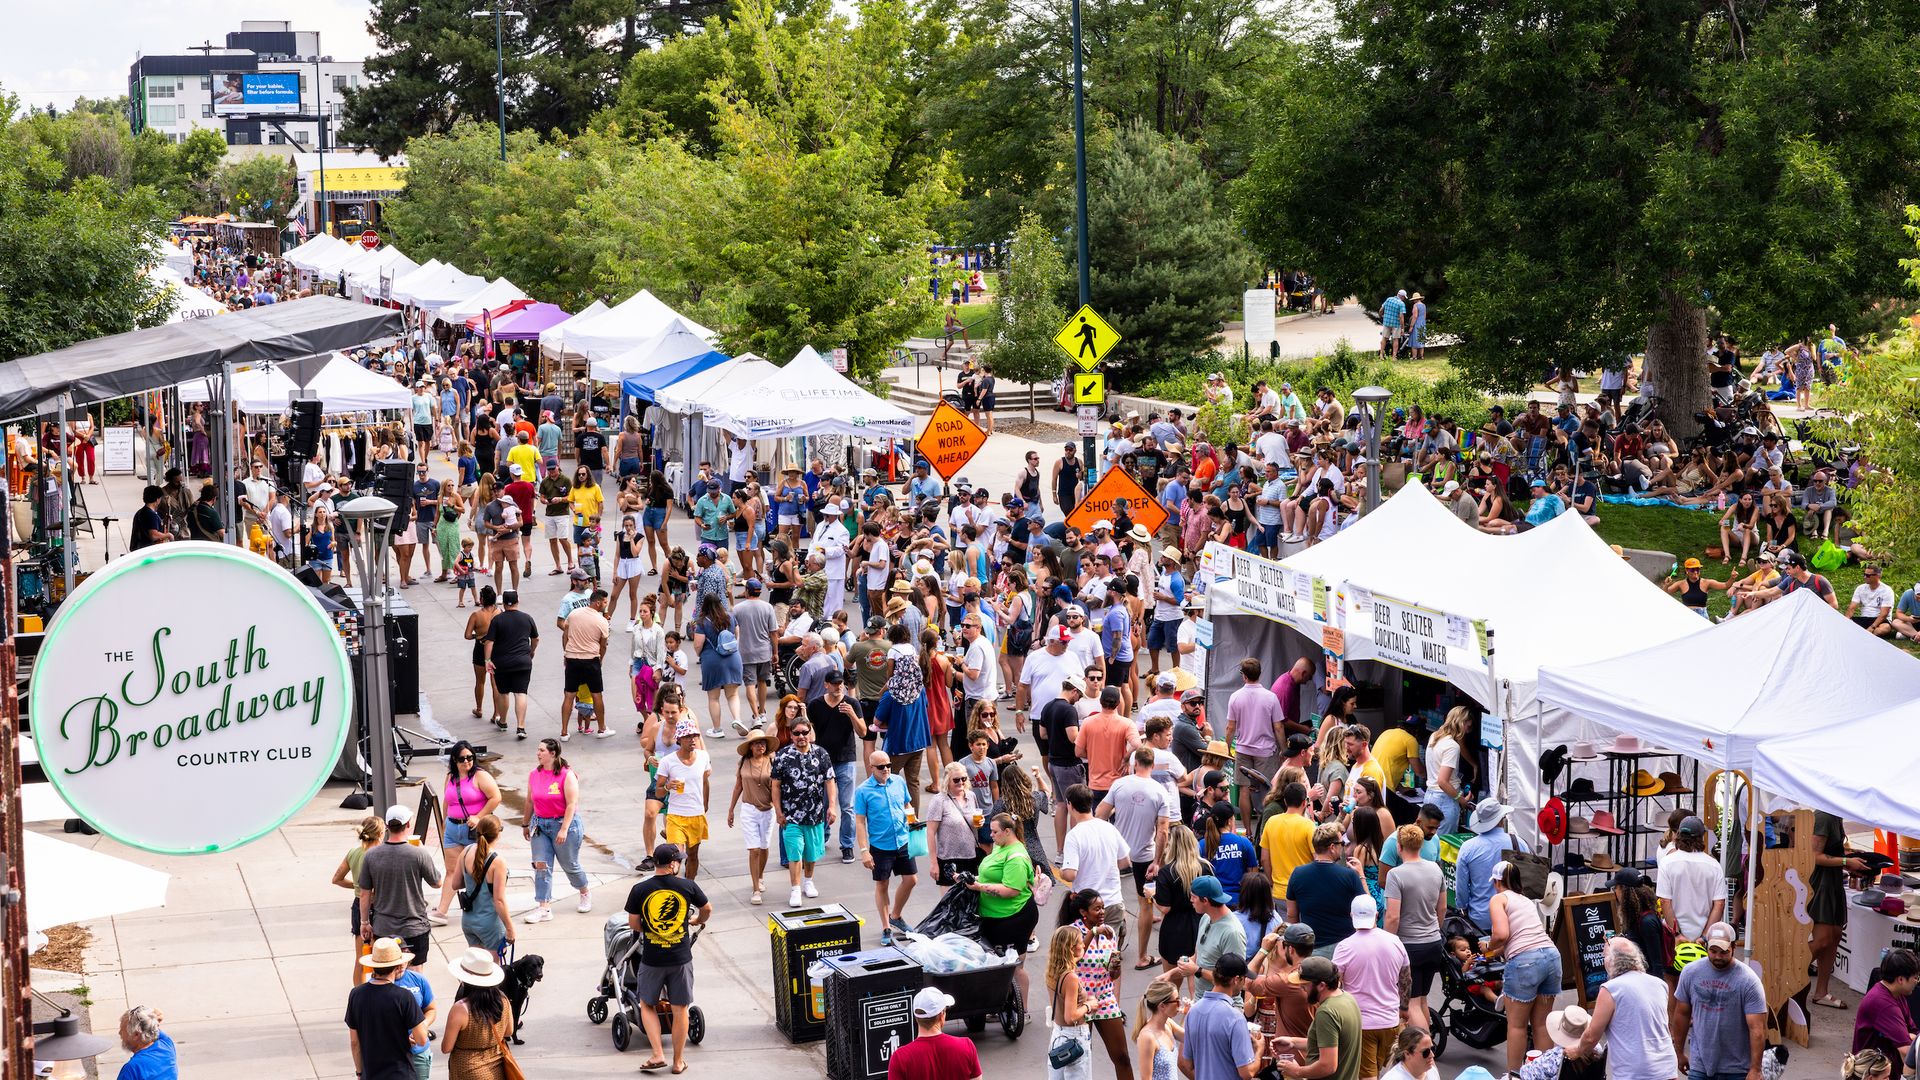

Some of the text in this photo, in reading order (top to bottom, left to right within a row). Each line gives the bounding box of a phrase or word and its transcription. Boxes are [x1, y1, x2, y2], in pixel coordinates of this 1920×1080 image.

[362, 235, 378, 243] STOP
[750, 418, 794, 427] INFINITY
[936, 420, 963, 432] ROAD
[938, 435, 966, 449] WORK
[936, 451, 970, 464] AHEAD
[1236, 557, 1251, 579] BEER
[1259, 564, 1285, 589] SELTZER
[1238, 579, 1268, 605] COCKTAILS
[1275, 591, 1297, 614] WATER
[1374, 602, 1391, 627] BEER
[1401, 610, 1434, 639] SELTZER
[1374, 627, 1447, 666] COCKTAILS WATER
[104, 651, 134, 663] THE
[122, 624, 270, 707] South
[60, 676, 325, 775] Broadway
[176, 746, 312, 767] COUNTRY CLUB
[1218, 844, 1238, 853] EAM
[1214, 851, 1243, 861] LAYER
[1588, 924, 1605, 939] gem
[816, 949, 843, 958] Please
[1586, 943, 1604, 952] CUSTO
[1591, 958, 1604, 968] HAT
[886, 1016, 904, 1024] BASURA
